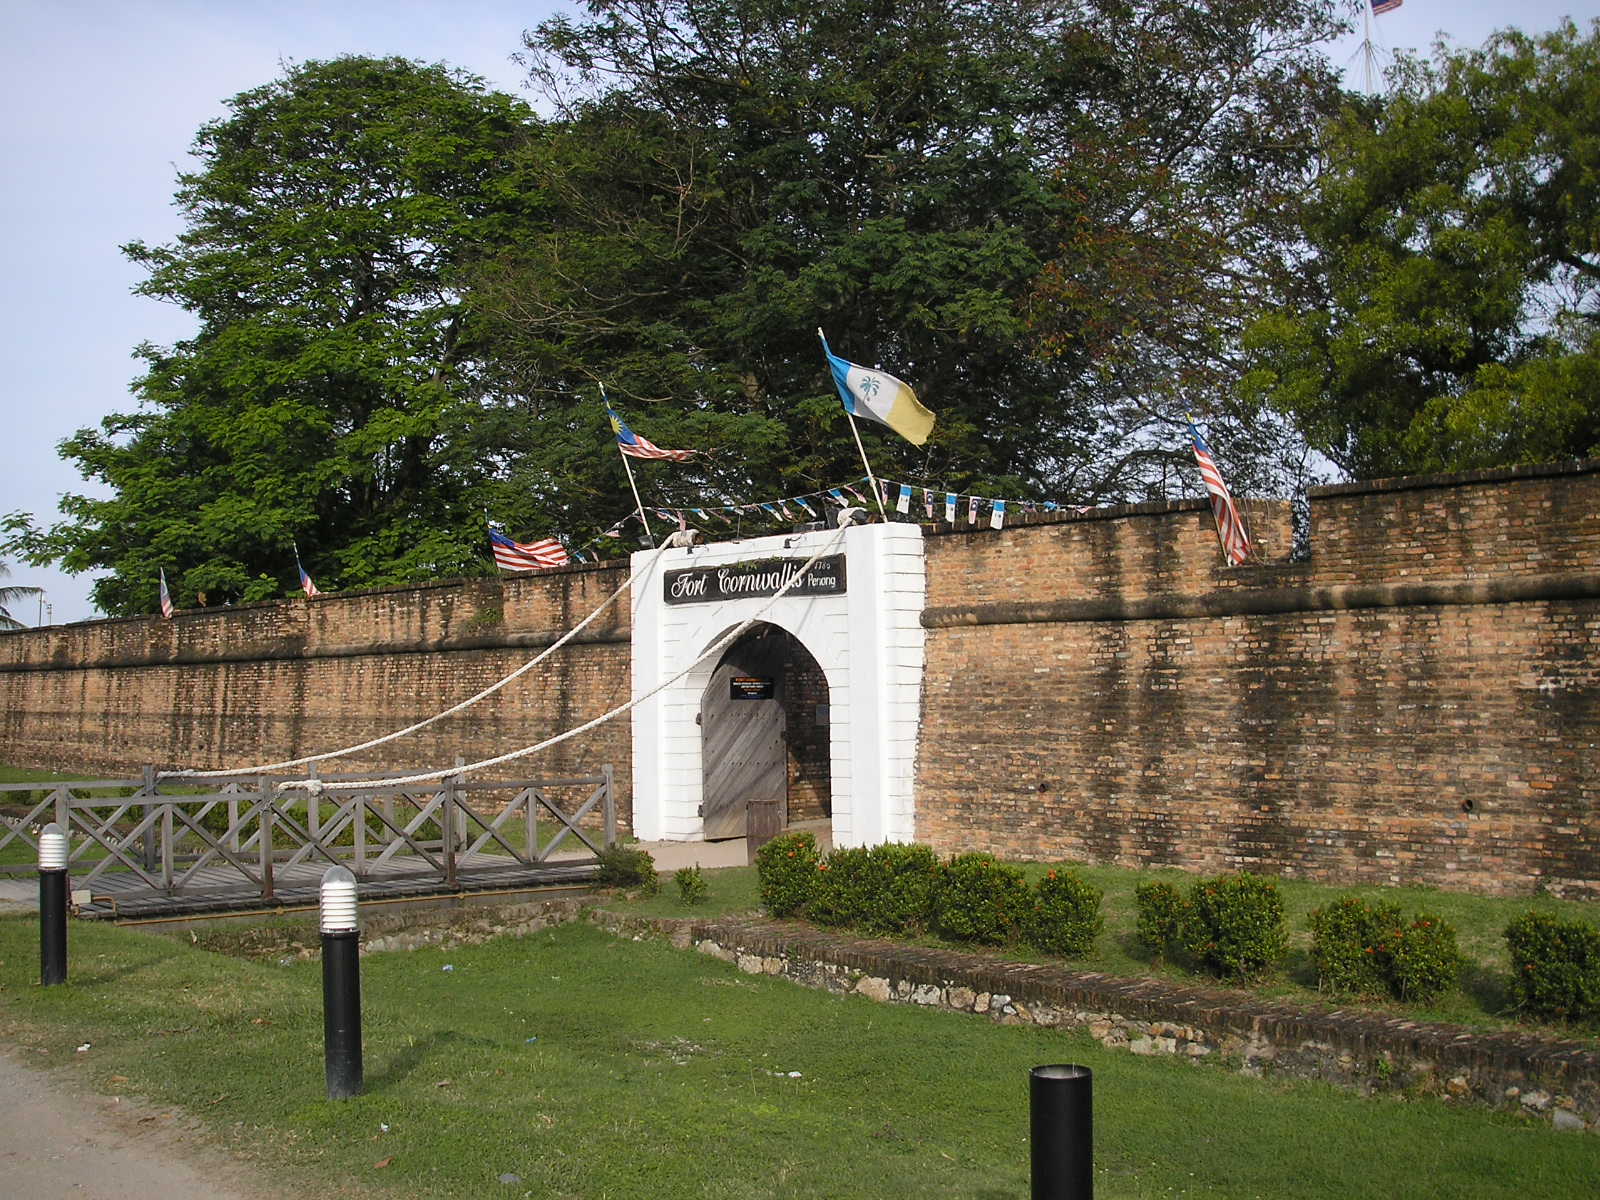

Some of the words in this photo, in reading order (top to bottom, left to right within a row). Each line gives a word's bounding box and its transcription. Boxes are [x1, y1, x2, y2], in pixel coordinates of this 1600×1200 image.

[671, 573, 708, 597] Fort
[716, 560, 803, 593] Cornwallis
[807, 573, 836, 589] Penang
